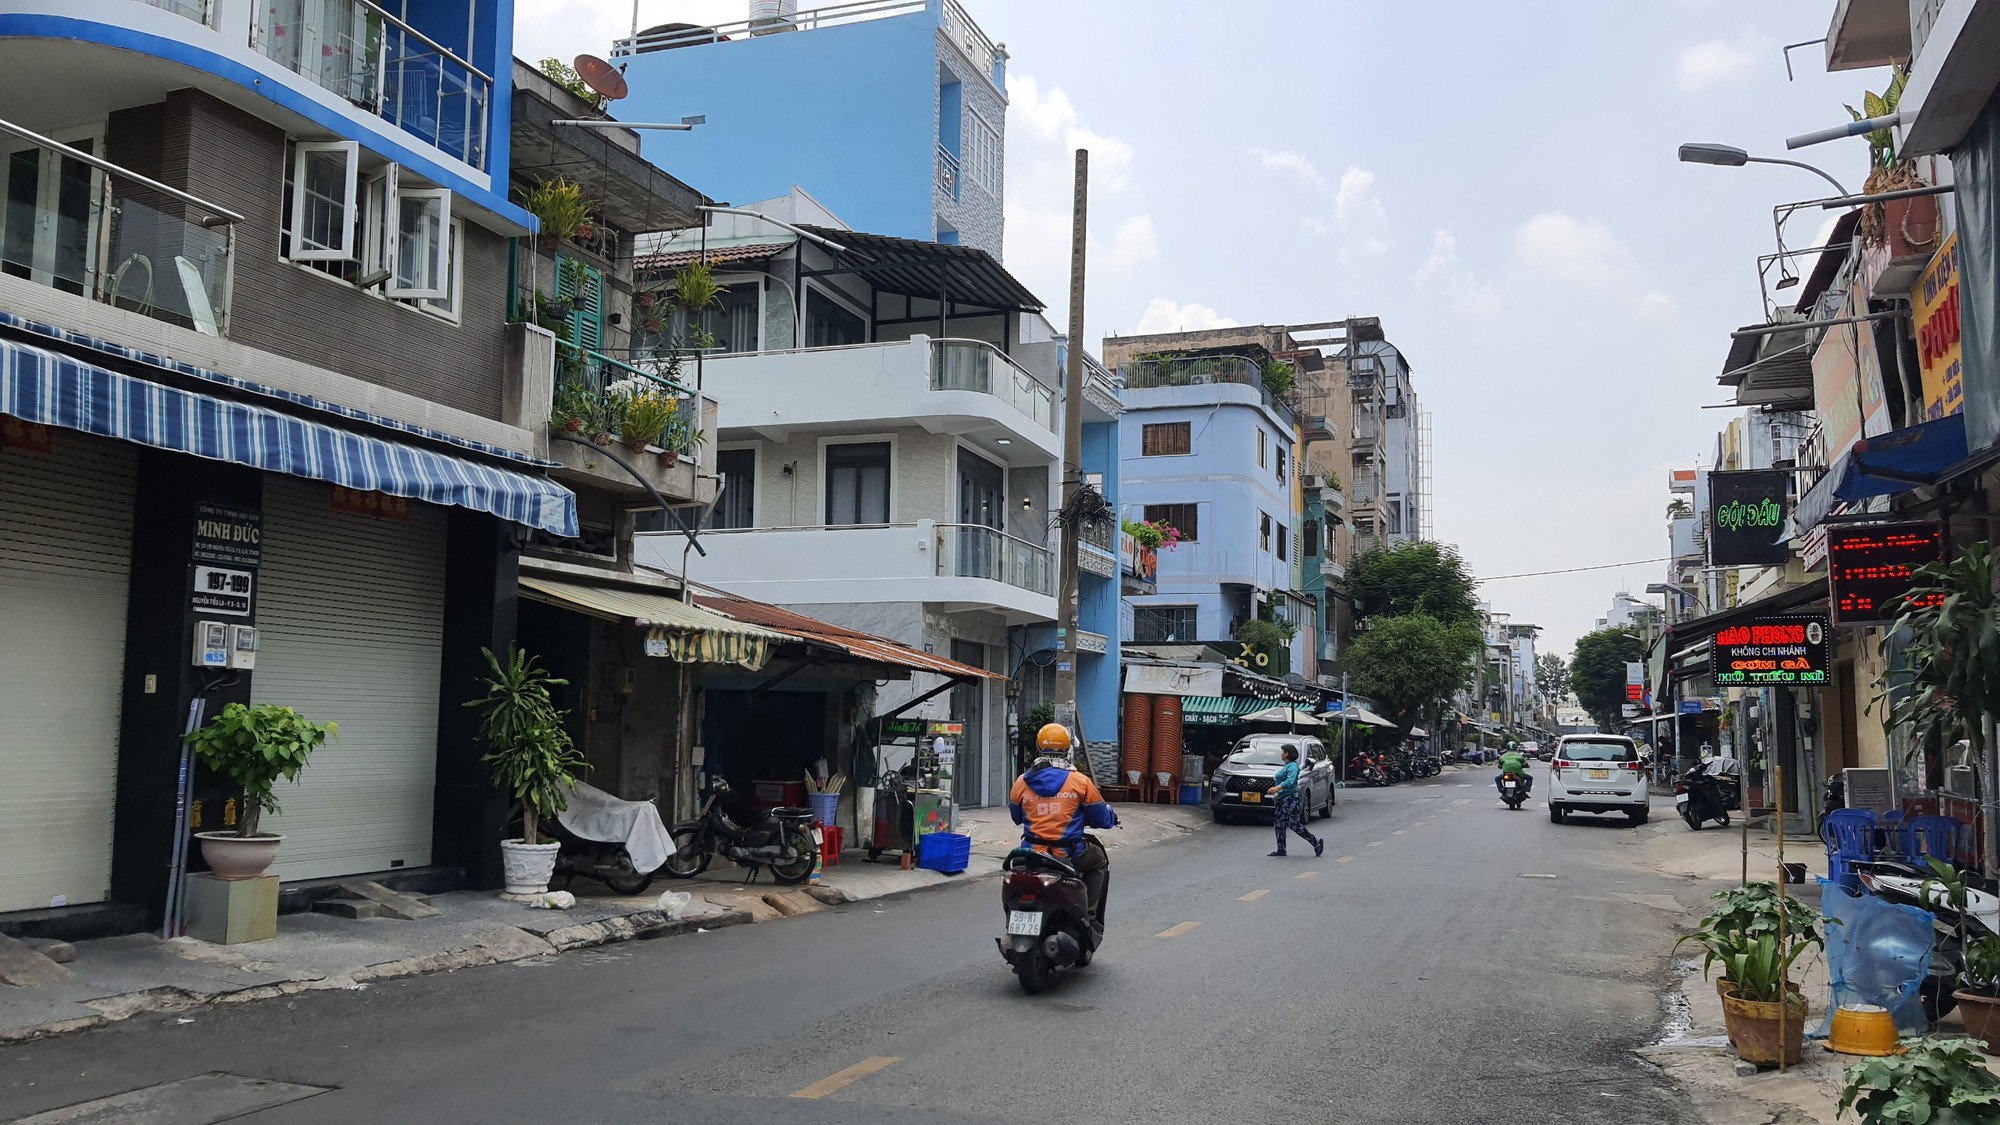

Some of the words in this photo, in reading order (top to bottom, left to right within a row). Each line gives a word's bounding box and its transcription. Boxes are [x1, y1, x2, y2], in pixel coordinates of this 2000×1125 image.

[197, 519, 231, 541] MINH
[233, 522, 260, 544] ĐỨC
[206, 571, 250, 593] 197-199
[1751, 625, 1805, 644] PHONG
[1731, 645, 1760, 656] KHÔNG
[1762, 647, 1776, 656] CHI
[1777, 645, 1807, 656] NHÁNH
[1731, 660, 1776, 669] CƠM
[1781, 657, 1810, 669] GÀ
[1749, 670, 1794, 681] TIẾU
[1800, 669, 1824, 681] MÌ
